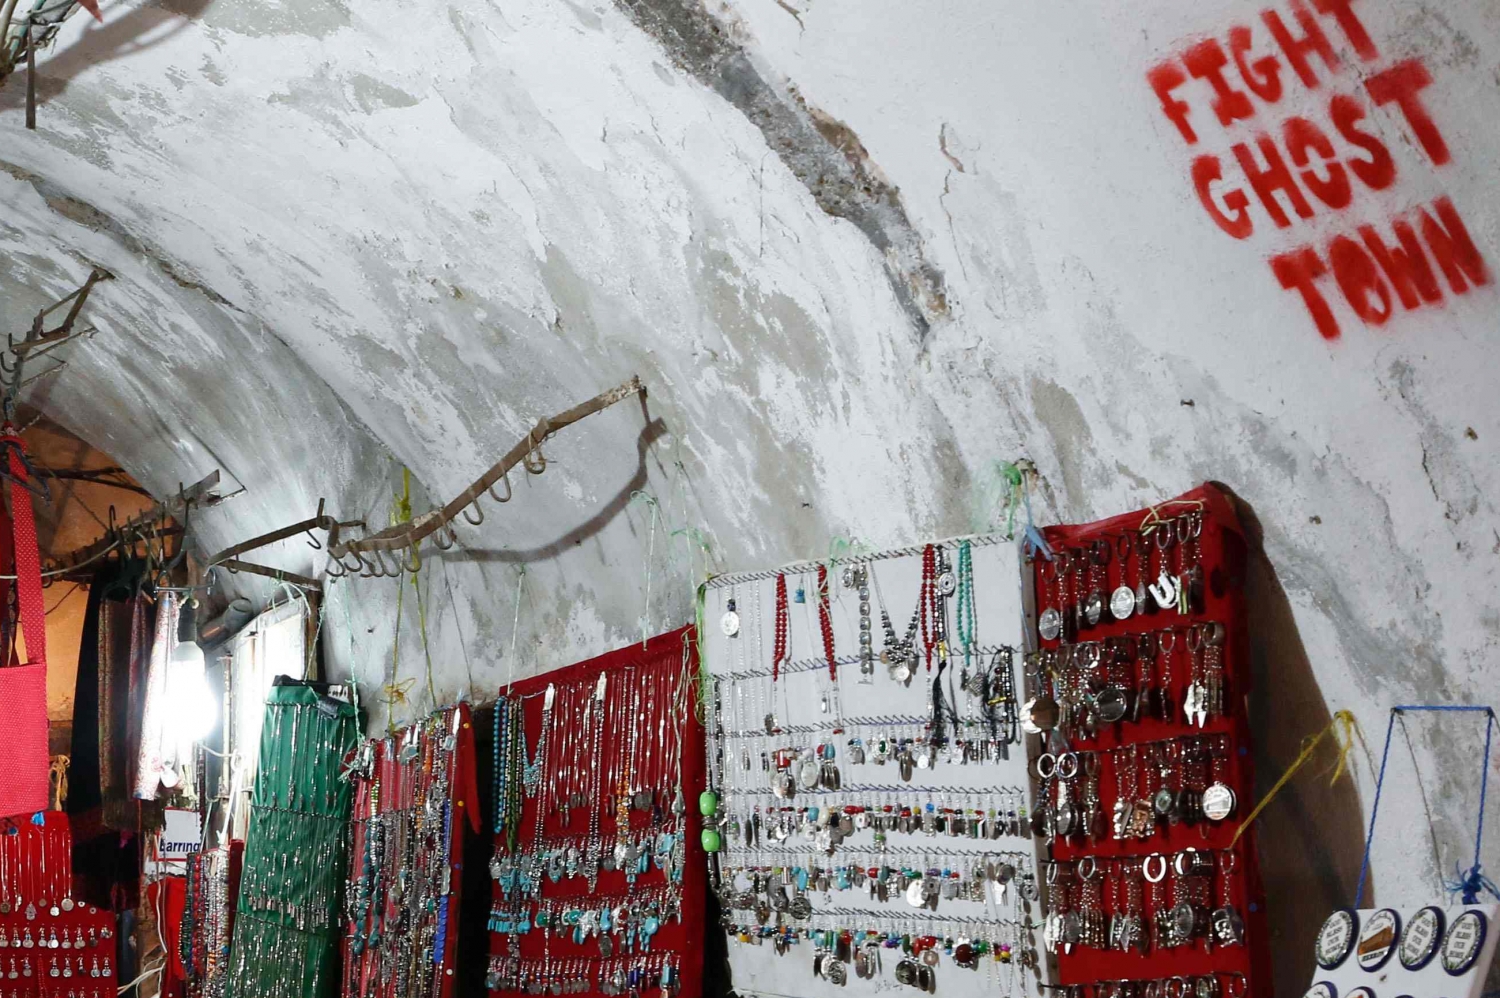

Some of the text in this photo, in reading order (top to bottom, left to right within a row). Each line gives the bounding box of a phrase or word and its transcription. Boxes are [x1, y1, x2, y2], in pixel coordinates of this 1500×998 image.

[1146, 0, 1380, 145] FIGHT
[1190, 57, 1452, 241] GHOST
[1267, 195, 1491, 342] TOWN
